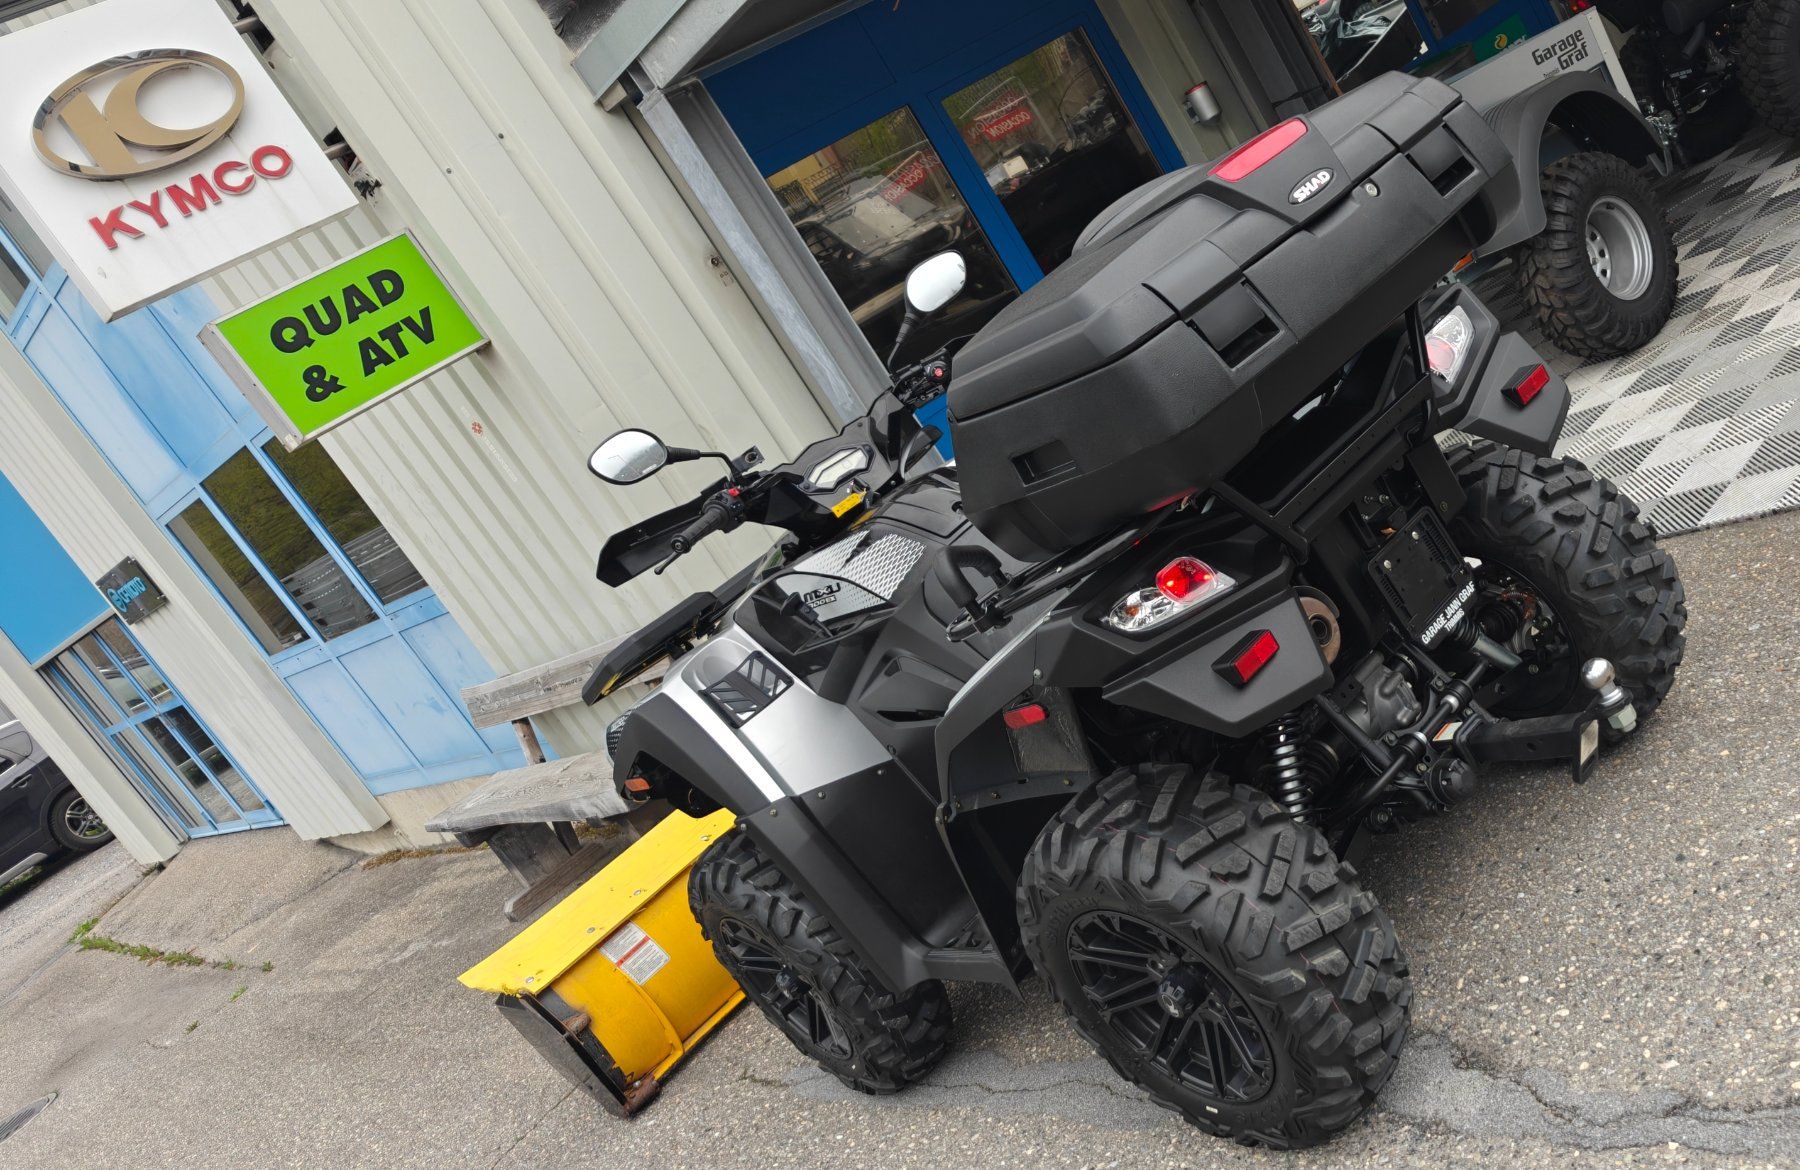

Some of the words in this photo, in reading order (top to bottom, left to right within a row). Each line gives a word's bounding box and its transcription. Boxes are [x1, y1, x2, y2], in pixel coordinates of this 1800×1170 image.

[1531, 29, 1585, 65] Garage
[1557, 41, 1589, 70] Graf
[88, 144, 293, 249] KYMCO
[1293, 171, 1331, 202] SHAD
[271, 269, 404, 353] QUAD
[303, 364, 346, 402] &
[359, 306, 436, 377] ATV
[1421, 613, 1448, 644] GARAGE
[1444, 597, 1462, 619] JANN
[1458, 580, 1475, 603] GRAF
